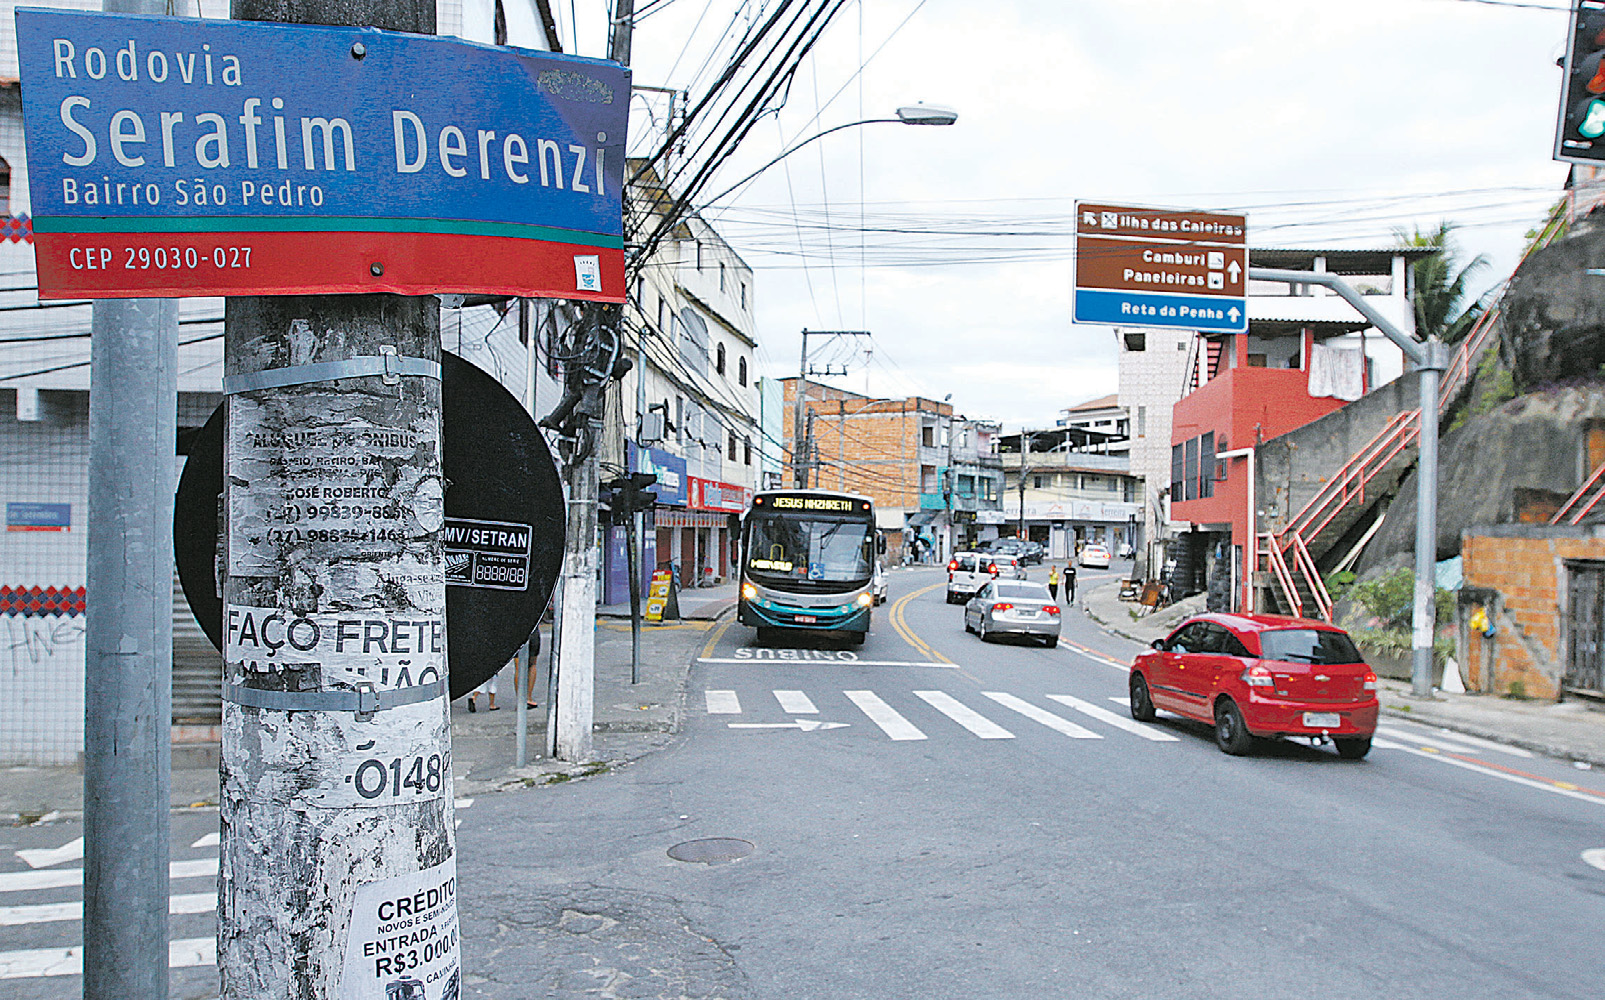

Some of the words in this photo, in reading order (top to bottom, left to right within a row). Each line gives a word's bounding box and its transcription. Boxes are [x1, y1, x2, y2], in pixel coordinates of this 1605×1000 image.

[53, 39, 242, 86] Rodovia
[60, 95, 356, 172] Serafim
[394, 109, 607, 196] Derenzi
[63, 178, 161, 206] Bairro
[175, 177, 227, 207] São
[242, 178, 324, 207] Pedro
[1120, 215, 1149, 230] Ilha
[1151, 218, 1178, 232] das
[69, 247, 113, 270] CEP
[124, 246, 253, 270] 29030-027
[1142, 250, 1206, 267] Camburi
[1123, 268, 1205, 286] Paneleiras
[1121, 302, 1156, 316] Reta
[1160, 305, 1176, 317] da
[1179, 306, 1224, 319] Penha
[323, 487, 390, 499] ROBERTO
[773, 497, 803, 509] JESUS
[228, 610, 321, 657] FAÇO
[378, 876, 455, 922] CRÉDITO
[377, 918, 413, 935] NOVOS
[415, 916, 421, 926] E
[363, 924, 438, 958] ENTRADA
